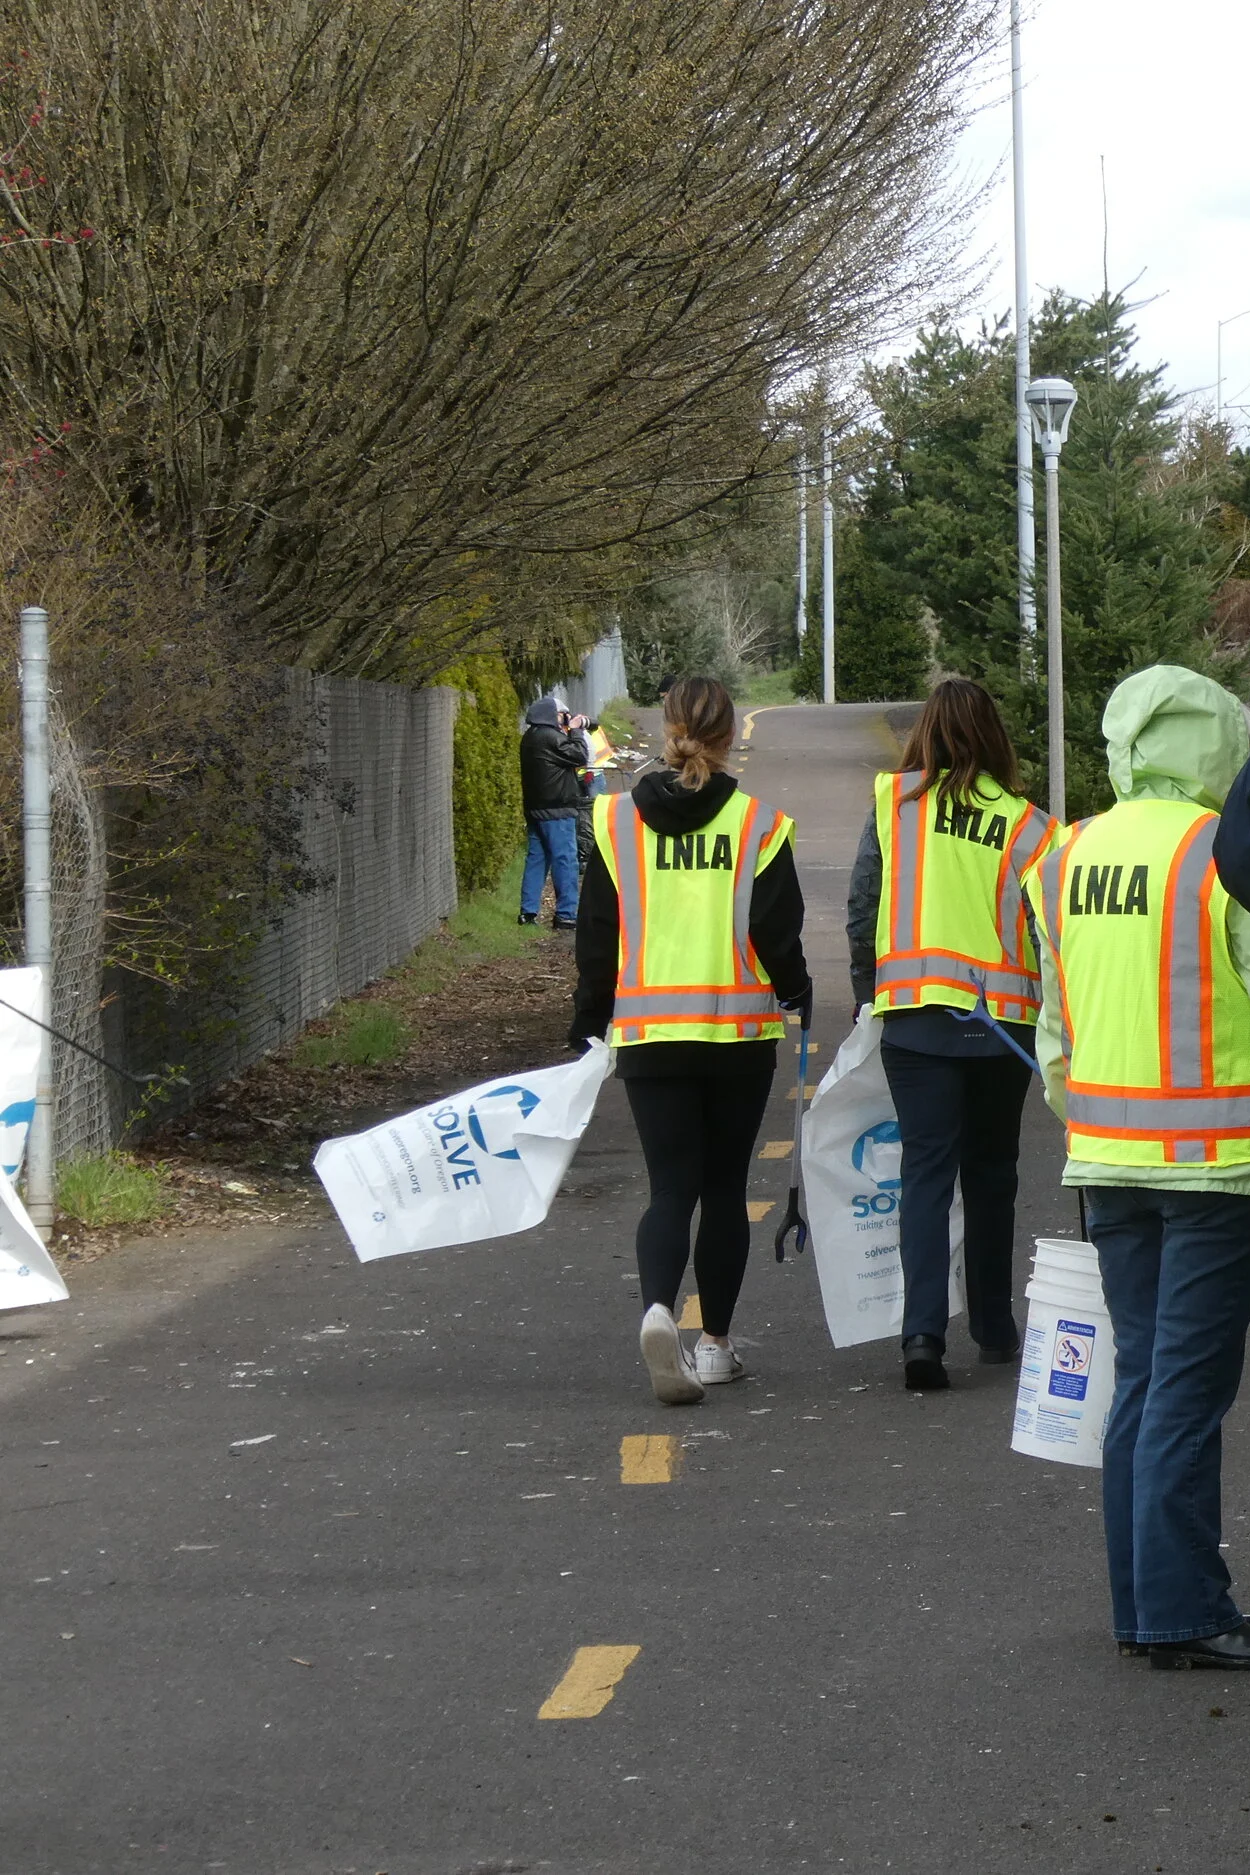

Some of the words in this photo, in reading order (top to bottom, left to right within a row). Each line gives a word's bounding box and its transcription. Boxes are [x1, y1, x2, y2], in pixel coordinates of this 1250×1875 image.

[934, 798, 1008, 851] LNLA
[656, 833, 733, 871] LNLA
[1069, 865, 1148, 916] LNLA
[428, 1104, 481, 1191] SOLVE
[855, 1220, 884, 1232] Taking
